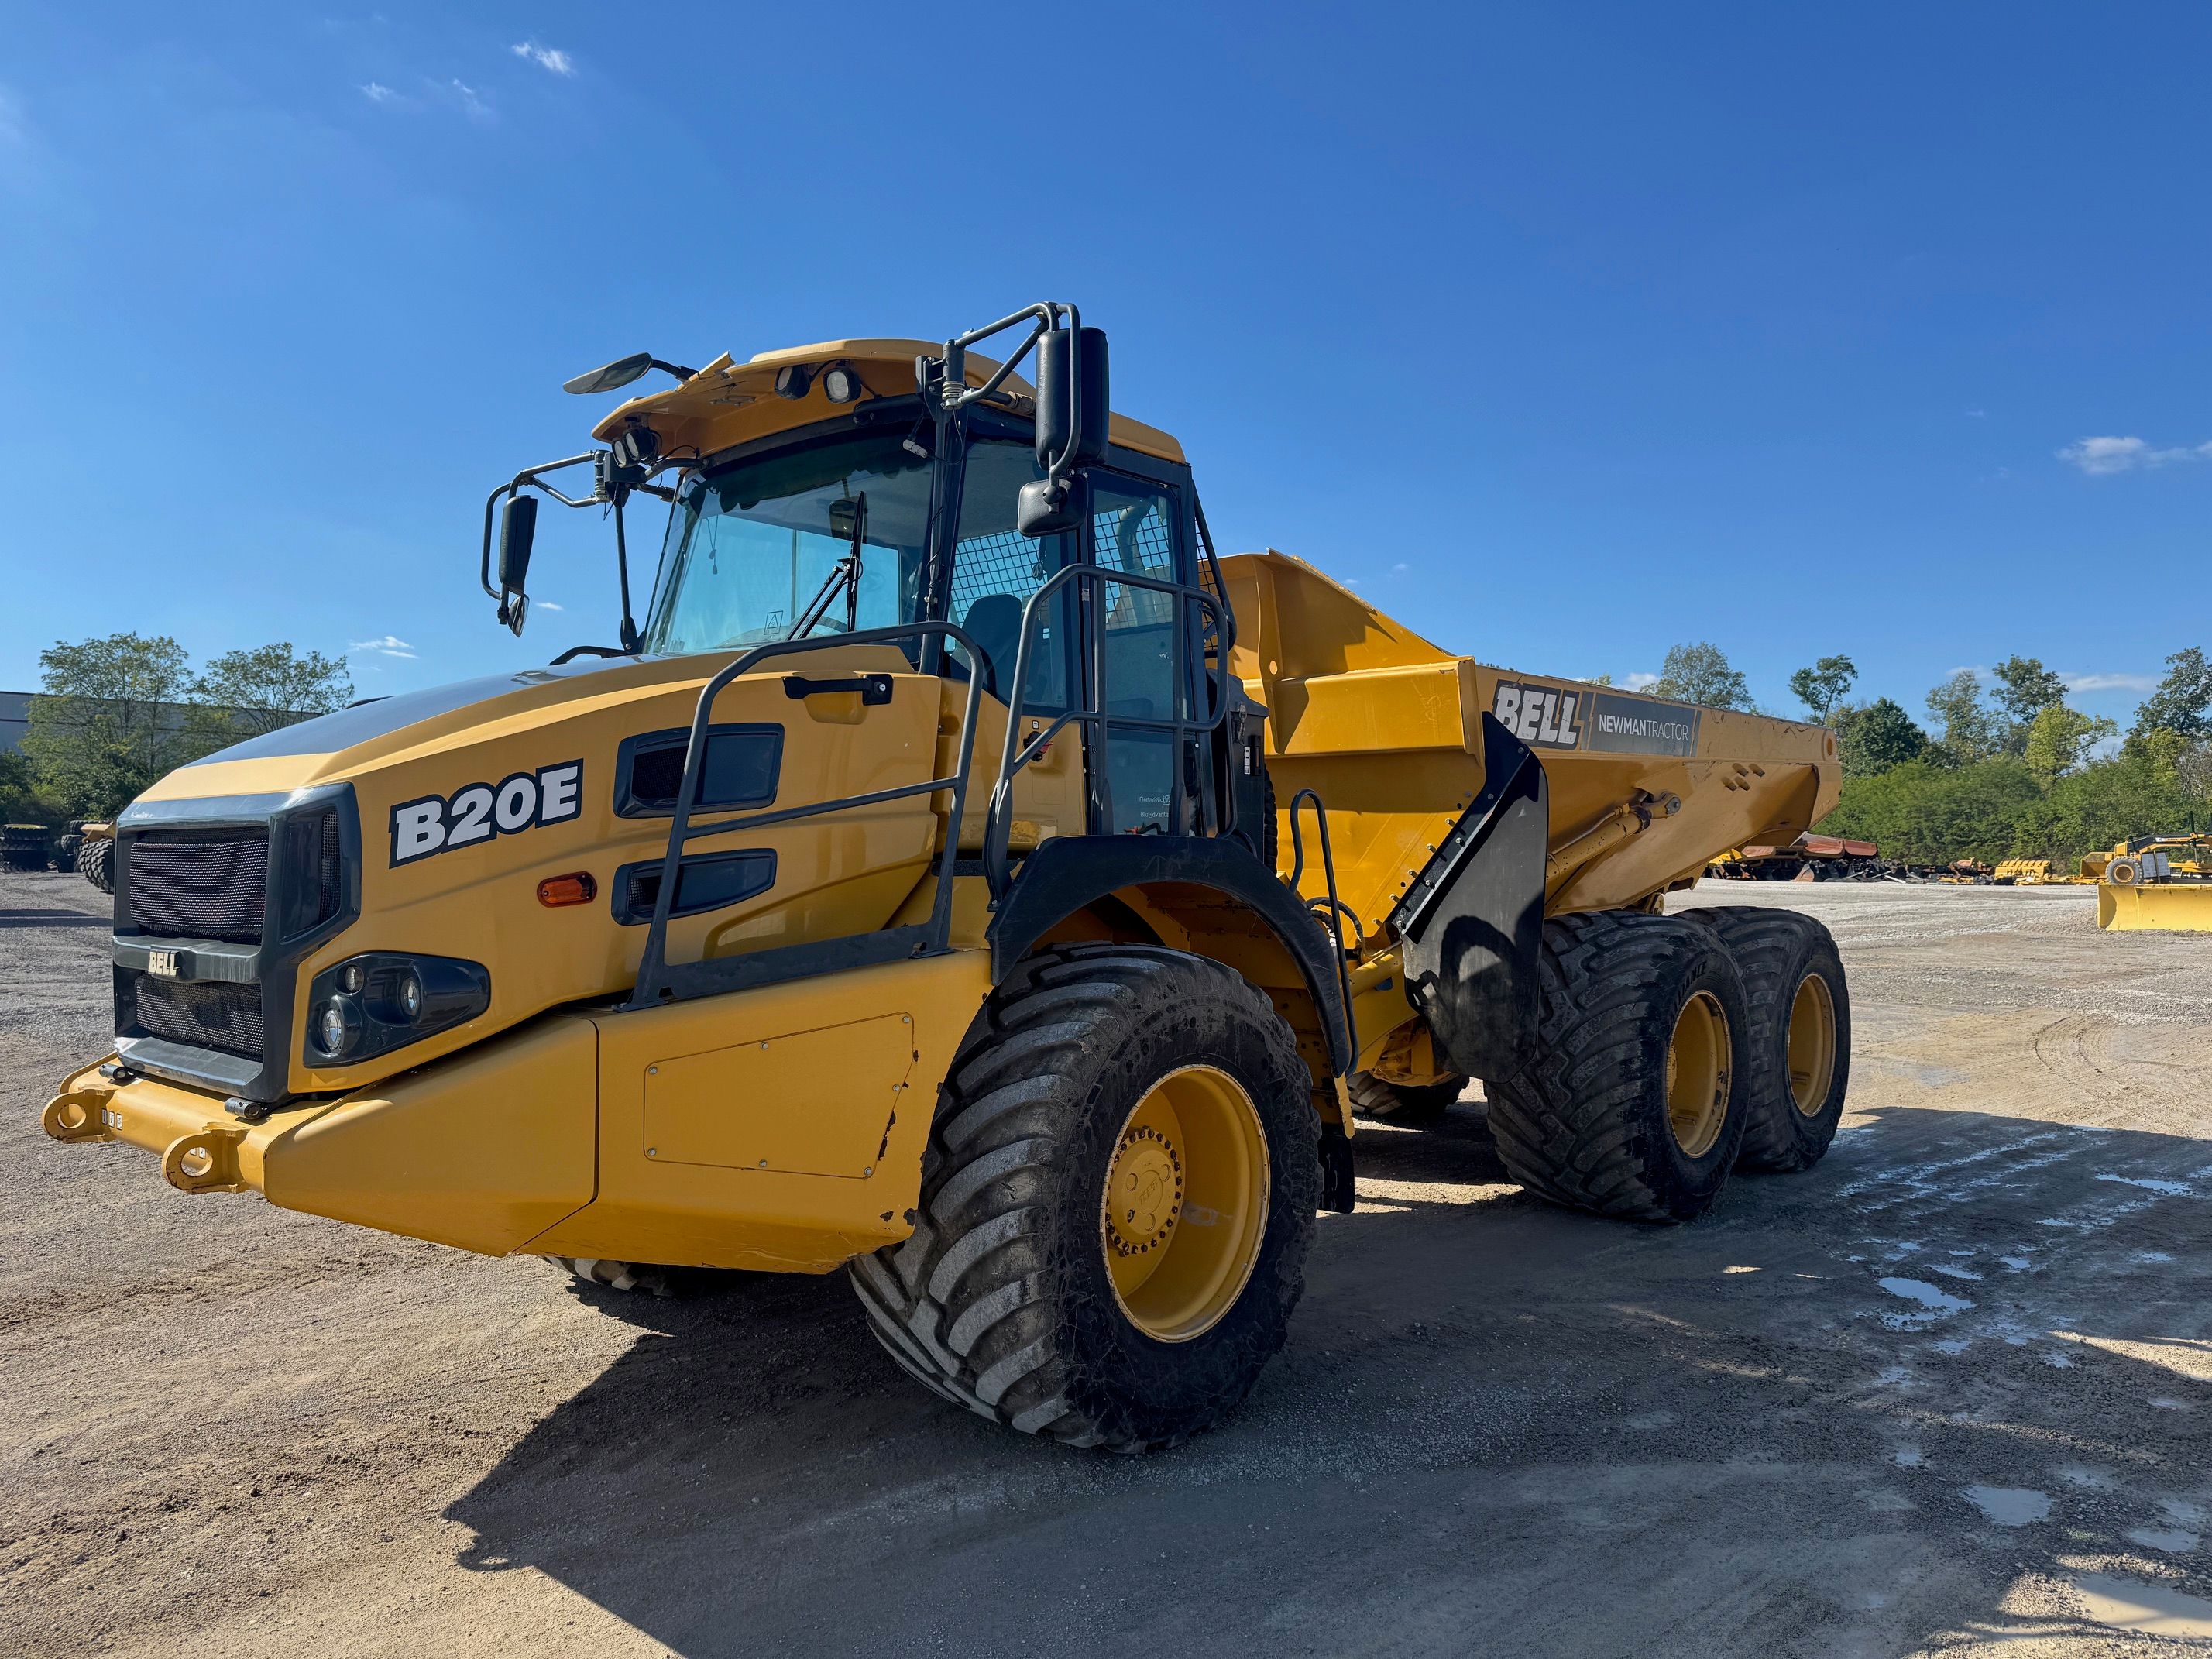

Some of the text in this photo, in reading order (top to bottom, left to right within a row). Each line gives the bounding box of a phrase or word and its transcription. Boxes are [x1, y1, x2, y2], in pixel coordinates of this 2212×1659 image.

[1494, 686, 1577, 744] BELL
[396, 766, 578, 860] B20E
[148, 951, 180, 976] BELL
